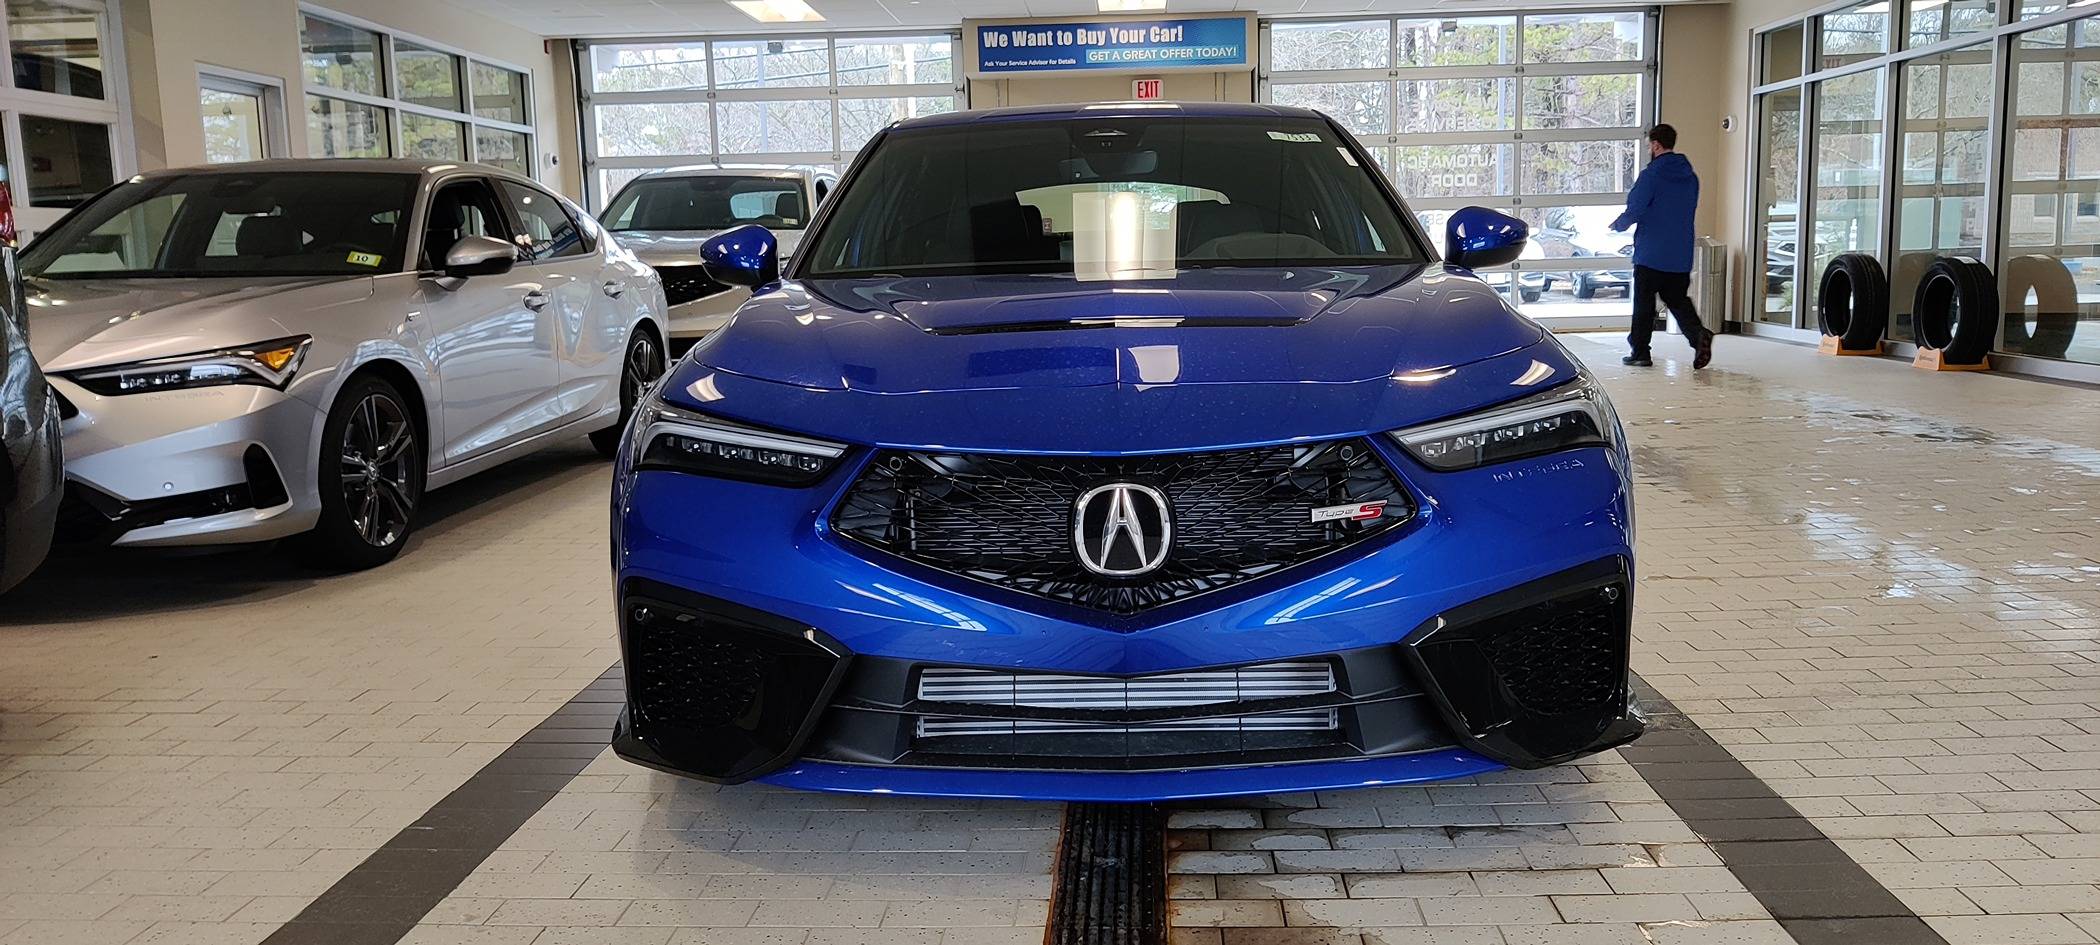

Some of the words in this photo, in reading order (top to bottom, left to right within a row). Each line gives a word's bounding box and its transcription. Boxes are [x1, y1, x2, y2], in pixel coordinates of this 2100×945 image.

[983, 31, 1008, 48] We
[1012, 30, 1053, 47] Want
[1056, 30, 1073, 46] to
[1076, 28, 1106, 46] Buy
[1109, 27, 1146, 44] Your
[1149, 25, 1183, 43] Car!
[1028, 59, 1048, 67] Advisor
[1057, 58, 1076, 66] Details
[1089, 51, 1110, 61] GET
[1112, 50, 1121, 60] A
[1122, 49, 1157, 60] GREAT
[1159, 48, 1193, 59] OFFER
[1195, 46, 1237, 57] TODAY!
[1137, 81, 1159, 99] EXIT
[1351, 499, 1388, 521] S
